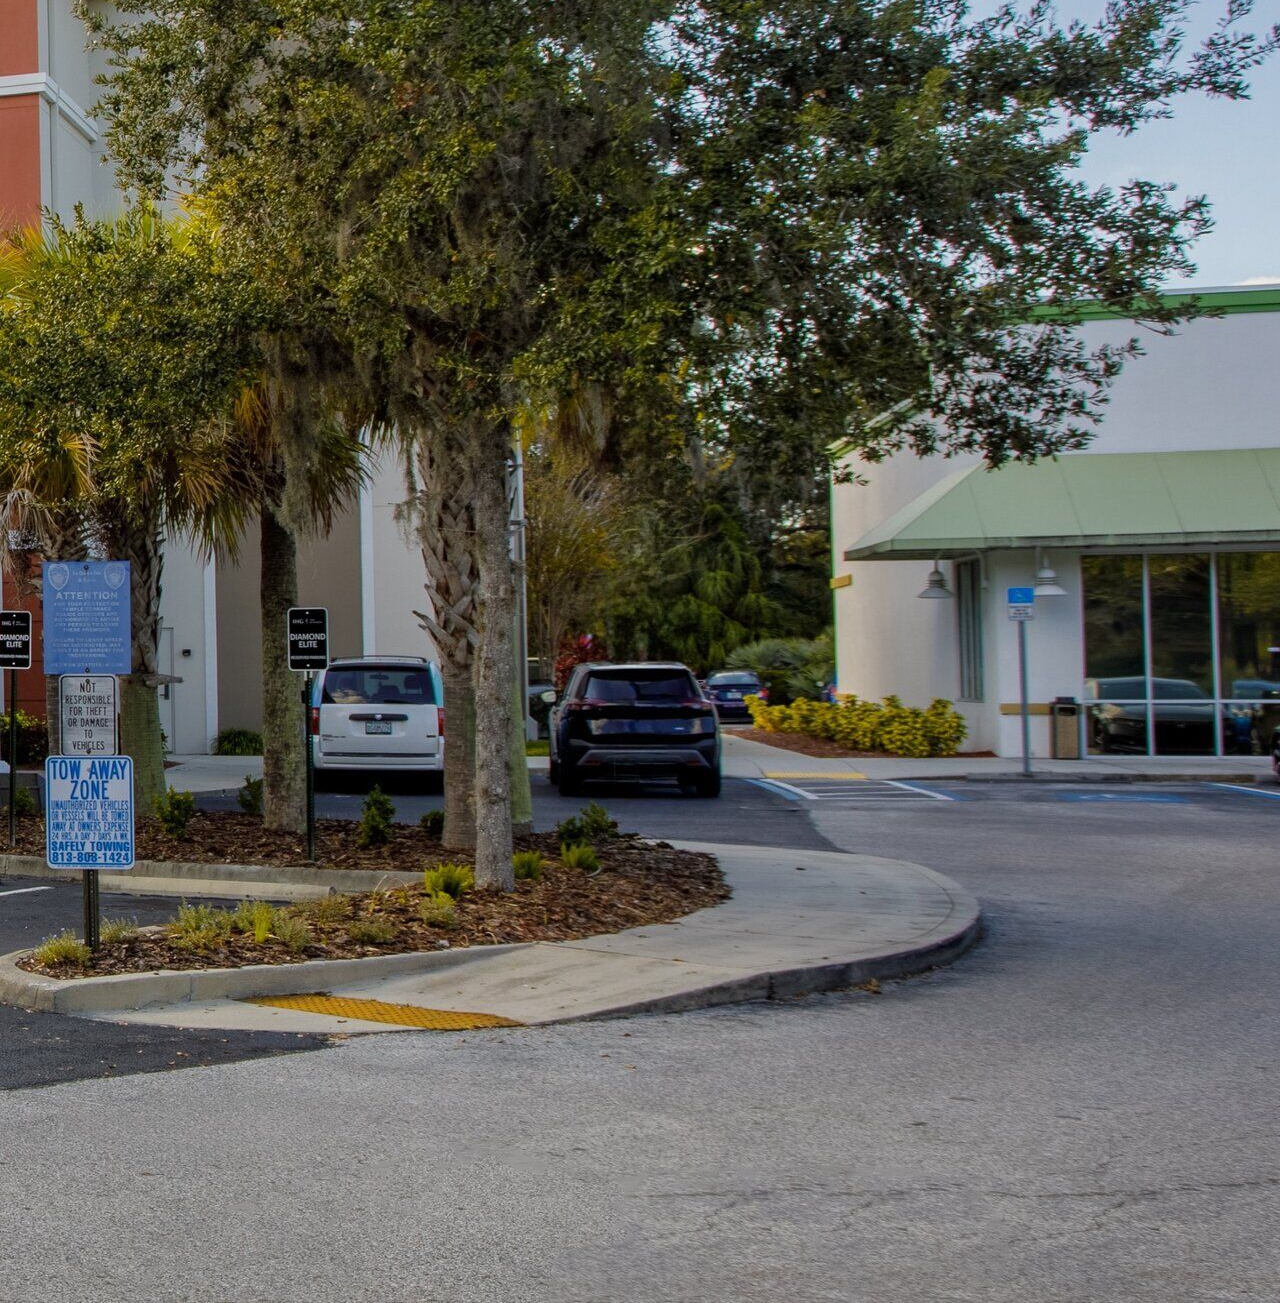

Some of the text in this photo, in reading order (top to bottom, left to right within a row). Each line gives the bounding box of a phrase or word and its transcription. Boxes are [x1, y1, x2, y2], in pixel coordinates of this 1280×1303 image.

[56, 591, 118, 600] ATTENTION
[290, 633, 326, 641] DIAMOND
[80, 683, 96, 693] NOT
[66, 695, 111, 705] RESPONSIBLE
[70, 707, 106, 715] FOR THEFT
[68, 719, 109, 727] OR DAMAGE
[84, 729, 92, 739] TO
[72, 741, 105, 750] VEHICLES
[50, 761, 128, 779] TOW AWAY
[70, 780, 109, 799] ZONE
[51, 800, 129, 810] UNAUTHORIZED VEHICLES
[52, 811, 129, 821] OR VESSELS WILL BE TOWED
[52, 821, 129, 831] AWAY AT OWNERS EXPENSE
[52, 832, 58, 841] 24
[74, 832, 78, 841] A
[80, 832, 90, 841] DAY
[92, 832, 96, 841] 7
[98, 832, 112, 841] DAYS
[114, 832, 118, 841] A
[52, 841, 130, 851] SAFELY TOWING
[52, 852, 130, 863] 813-808-1424
